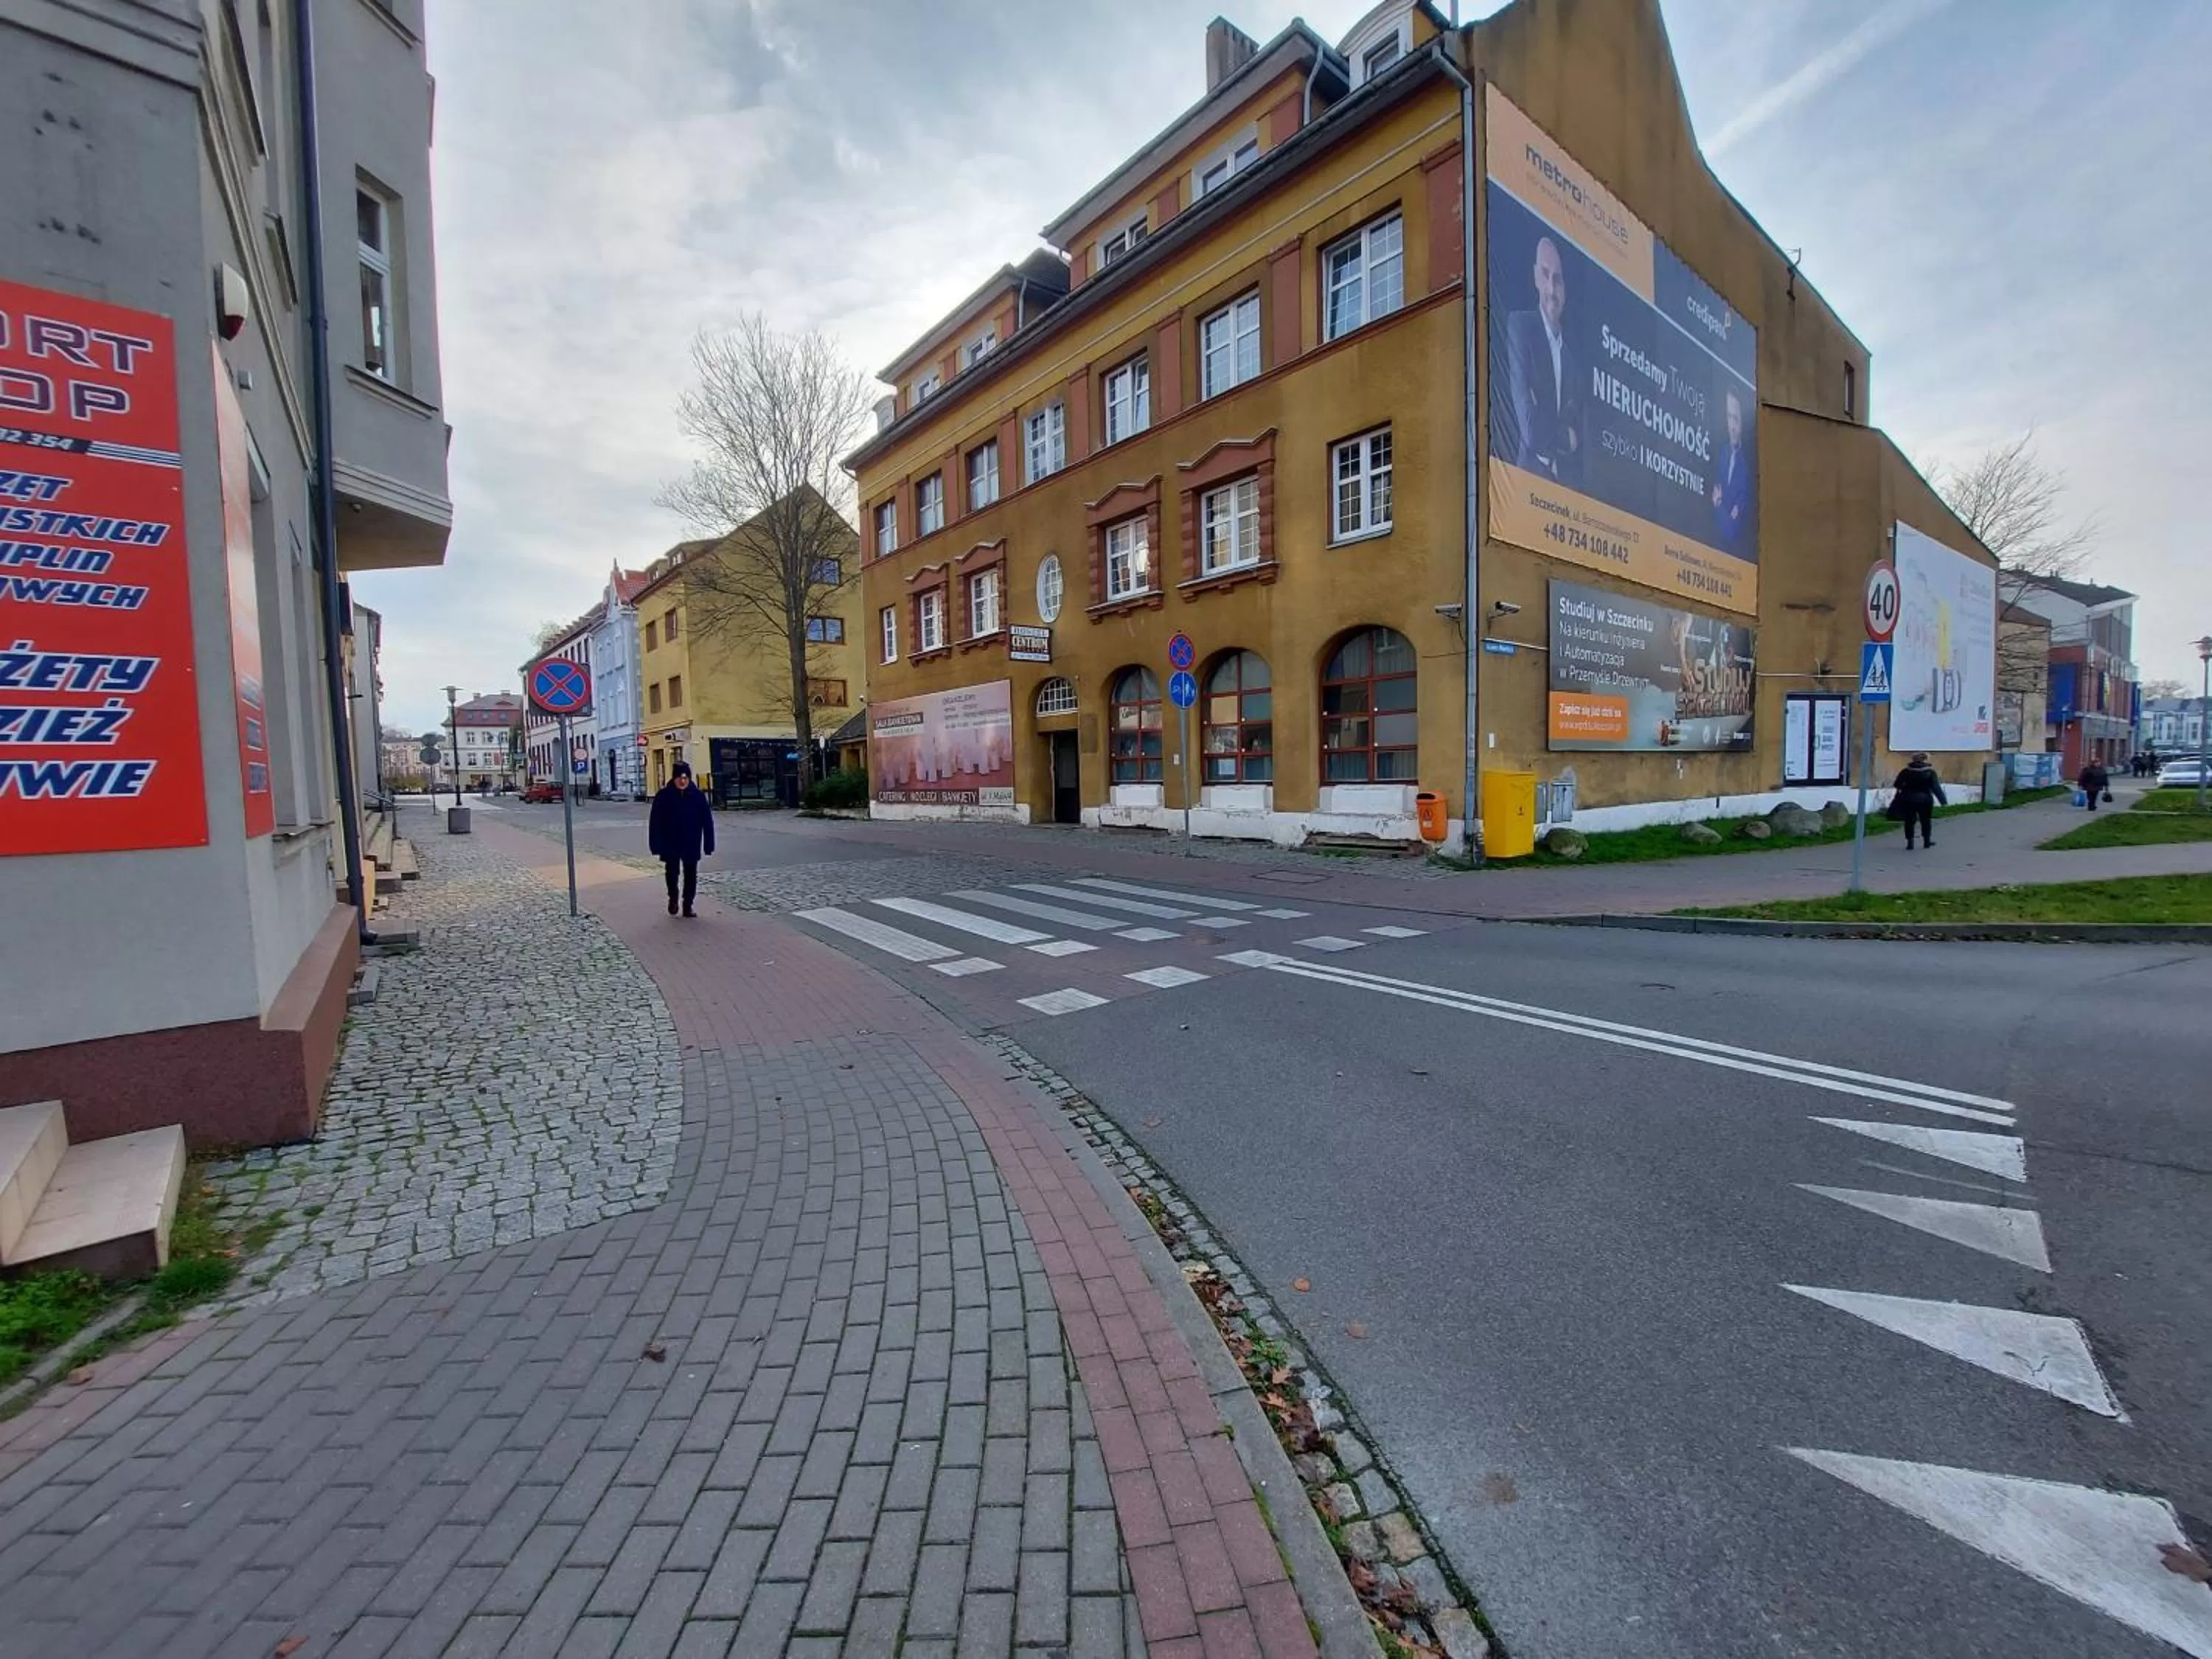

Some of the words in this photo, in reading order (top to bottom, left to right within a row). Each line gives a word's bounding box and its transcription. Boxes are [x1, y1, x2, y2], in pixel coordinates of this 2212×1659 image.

[1526, 144, 1629, 244] metrohouse
[0, 310, 153, 375] RT
[1601, 324, 1667, 392] Sprzedamy
[1593, 366, 1711, 462] NIERUCHOMOŚĆ
[26, 432, 74, 450] 354
[1646, 448, 1705, 496] KORZYSTNIE
[1543, 521, 1565, 543] +48
[1568, 526, 1587, 551] 734
[1590, 535, 1609, 557] 108
[1610, 543, 1630, 564] 442
[1559, 597, 1596, 623] Studiuj
[1596, 608, 1606, 623] w
[1607, 608, 1654, 633] Szczecinku
[1869, 582, 1895, 621] 40
[1012, 635, 1048, 650] CENTRUM
[1559, 619, 1572, 637] Na
